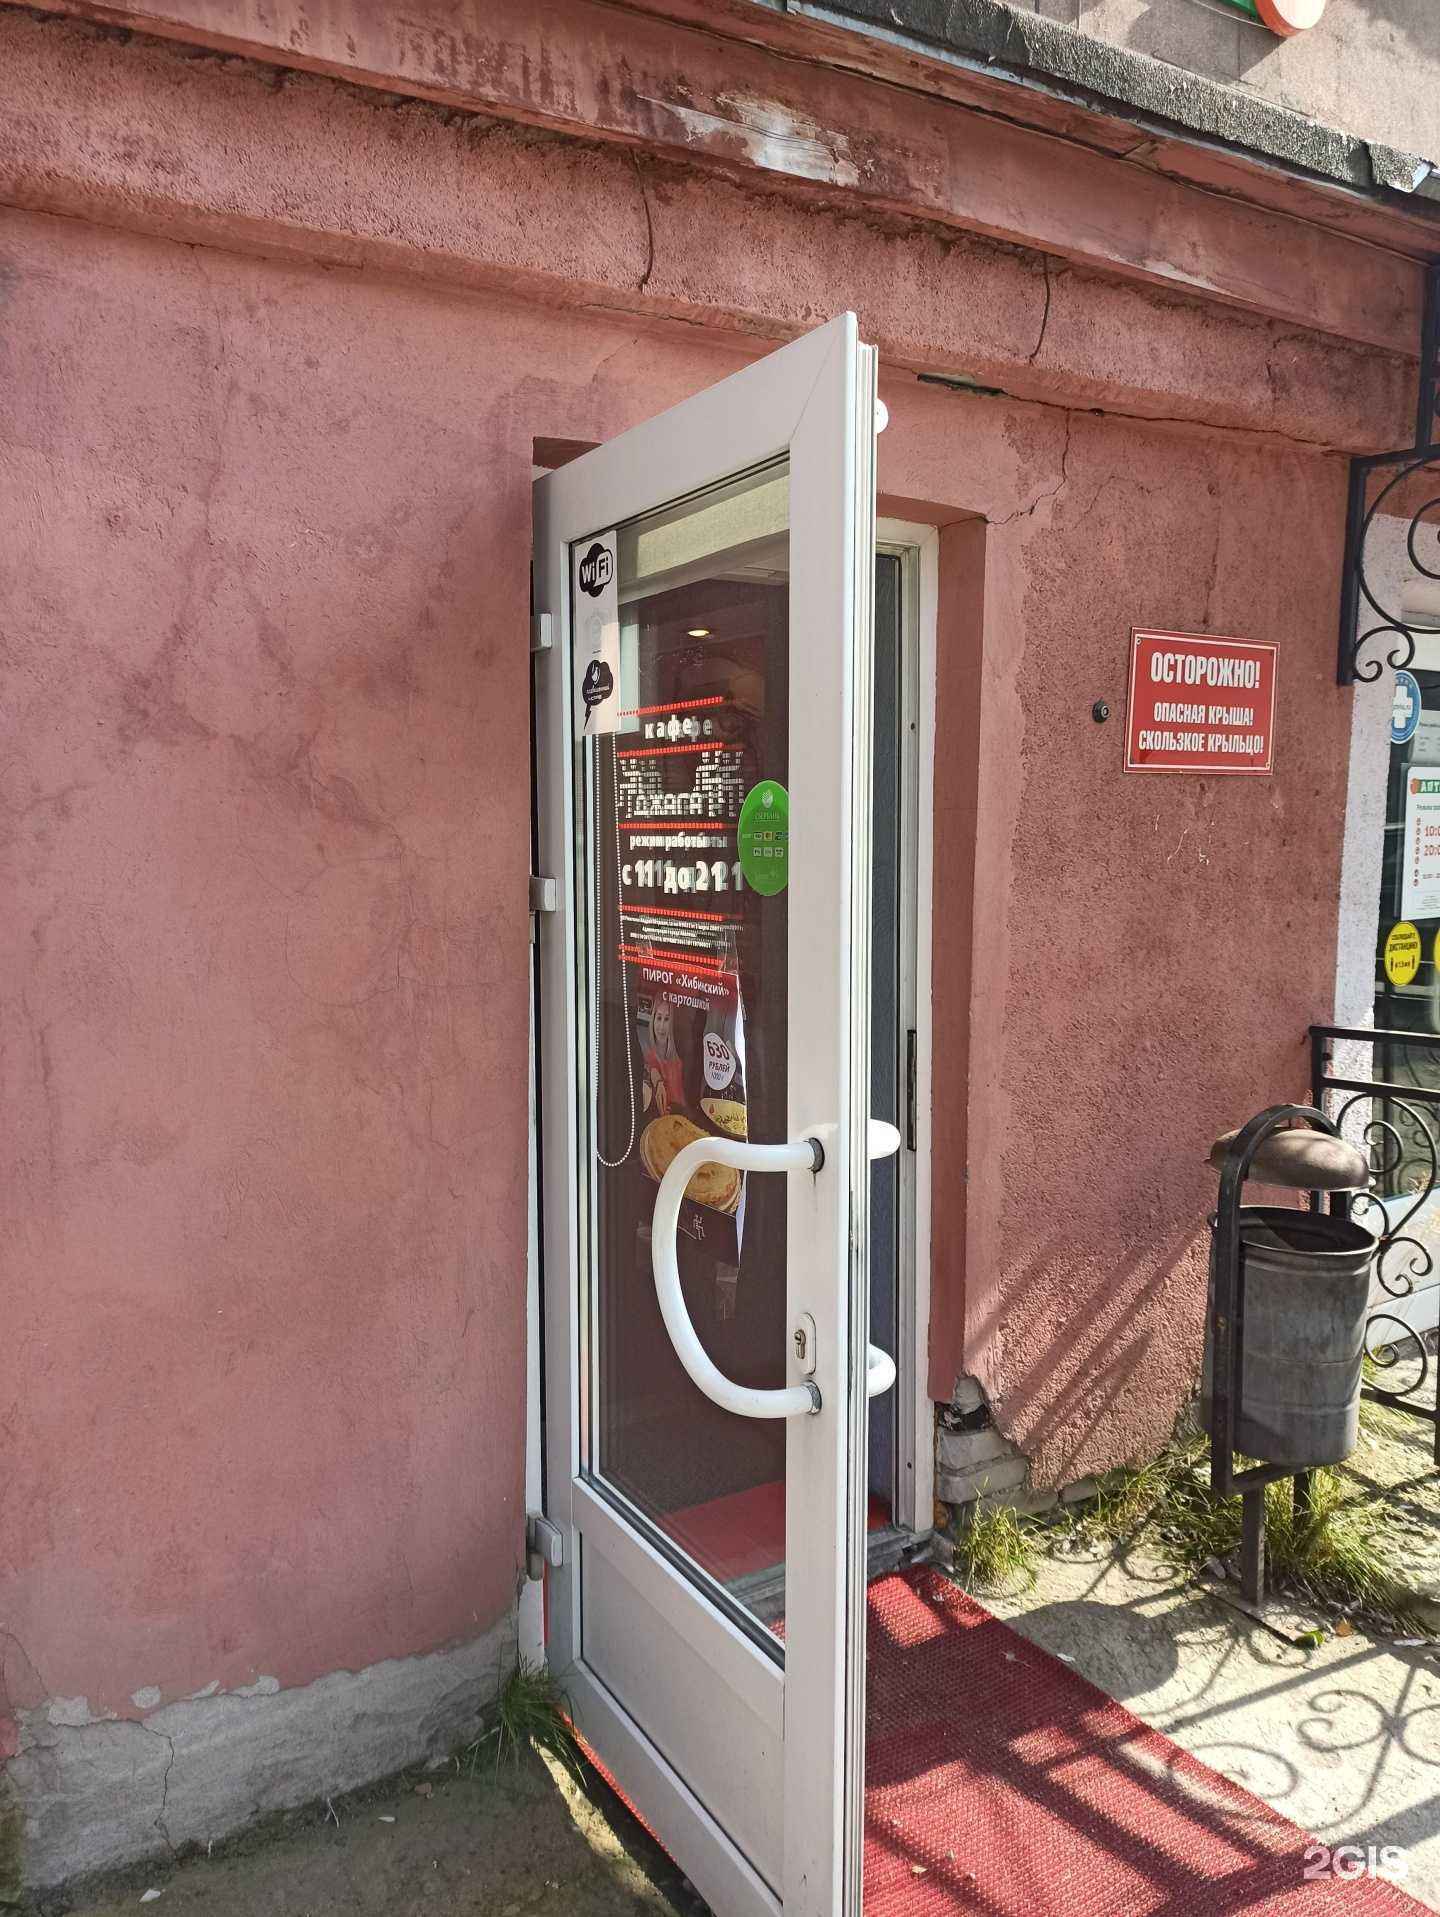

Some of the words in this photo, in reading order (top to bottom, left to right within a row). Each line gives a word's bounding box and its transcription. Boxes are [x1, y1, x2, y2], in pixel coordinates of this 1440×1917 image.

[581, 556, 609, 584] WiFi
[1151, 651, 1261, 689] ОСТОРОЖНО!
[1154, 702, 1205, 724] ОПАСНАЯ
[1208, 705, 1253, 726] КРЫША!
[645, 714, 694, 742] кафе
[1138, 730, 1205, 752] СКОЛЬЗКОЕ
[1207, 733, 1264, 756] КРЫЛЬЦО!
[630, 835, 664, 851] режим
[642, 967, 674, 985] ПИРОГ
[708, 1061, 731, 1073] РУБЛЕЙ
